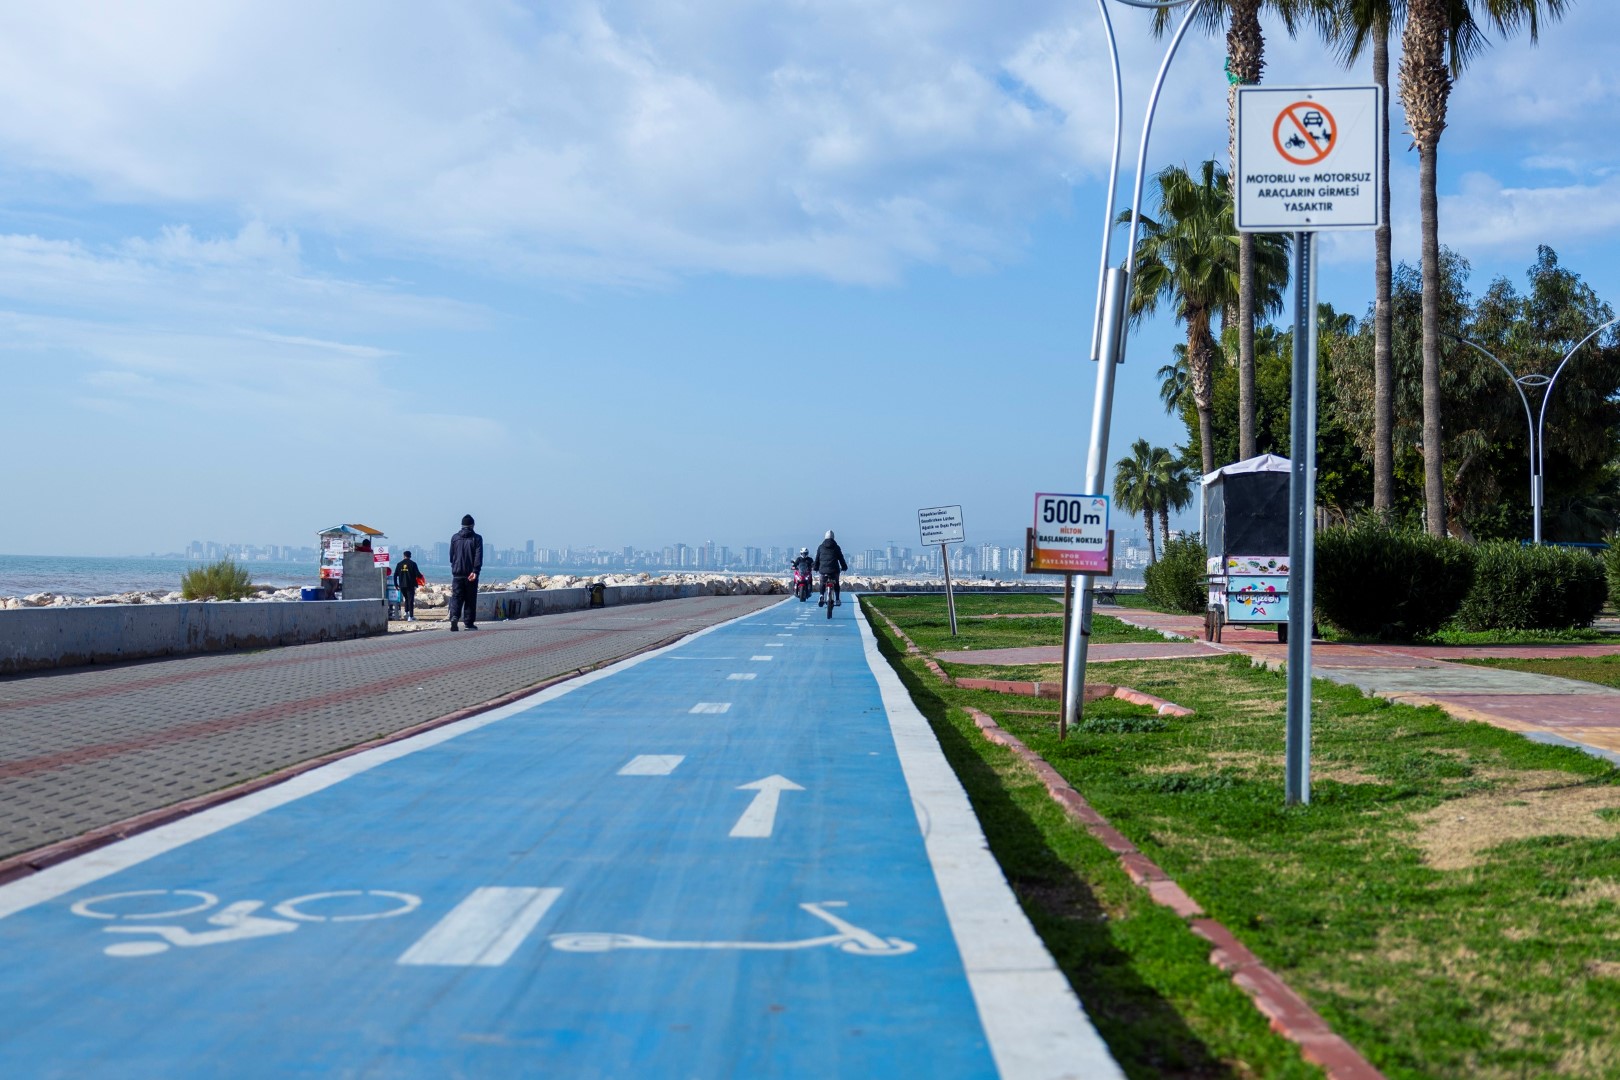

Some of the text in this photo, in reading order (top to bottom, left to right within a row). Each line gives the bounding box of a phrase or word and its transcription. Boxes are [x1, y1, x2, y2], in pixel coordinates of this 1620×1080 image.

[1246, 172, 1372, 184] MOTORLU ve MOTORSUZ
[1258, 185, 1360, 199] ARAÇLARIN GİRMESİ
[1284, 202, 1333, 212] YASAKTIR
